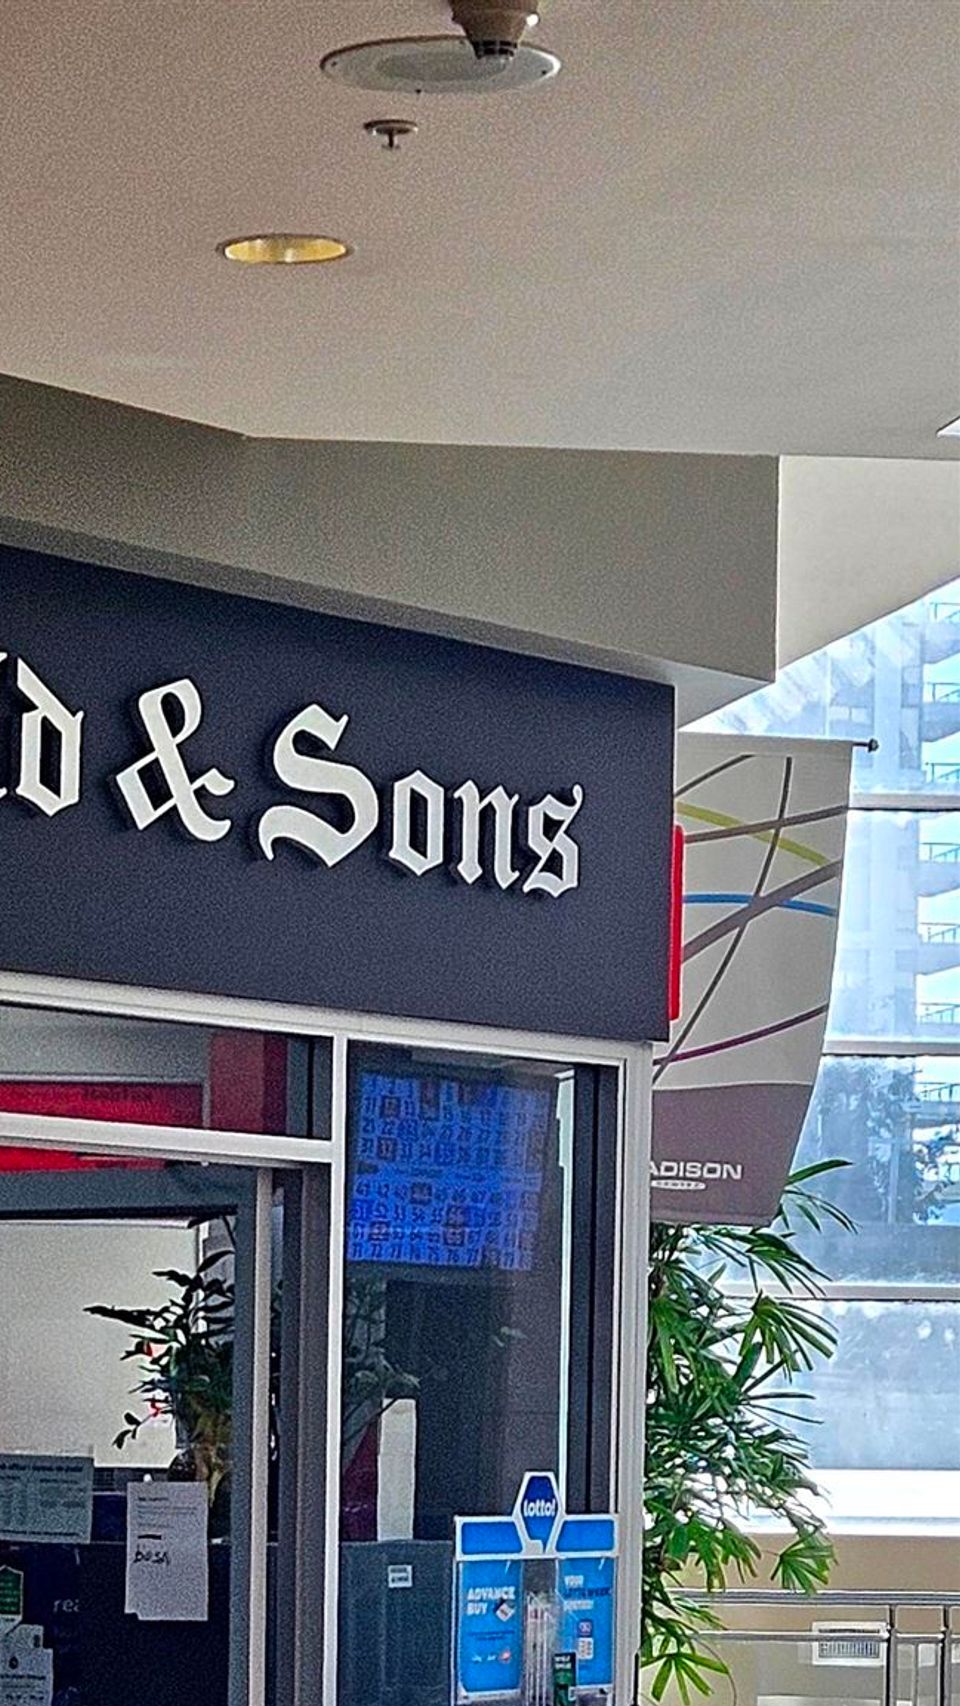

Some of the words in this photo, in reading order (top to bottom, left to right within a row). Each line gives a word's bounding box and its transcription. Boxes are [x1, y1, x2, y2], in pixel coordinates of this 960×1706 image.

[116, 678, 235, 843] &
[258, 703, 584, 898] Sons
[524, 1499, 556, 1517] lotto!
[467, 1586, 516, 1600] ADVANCE
